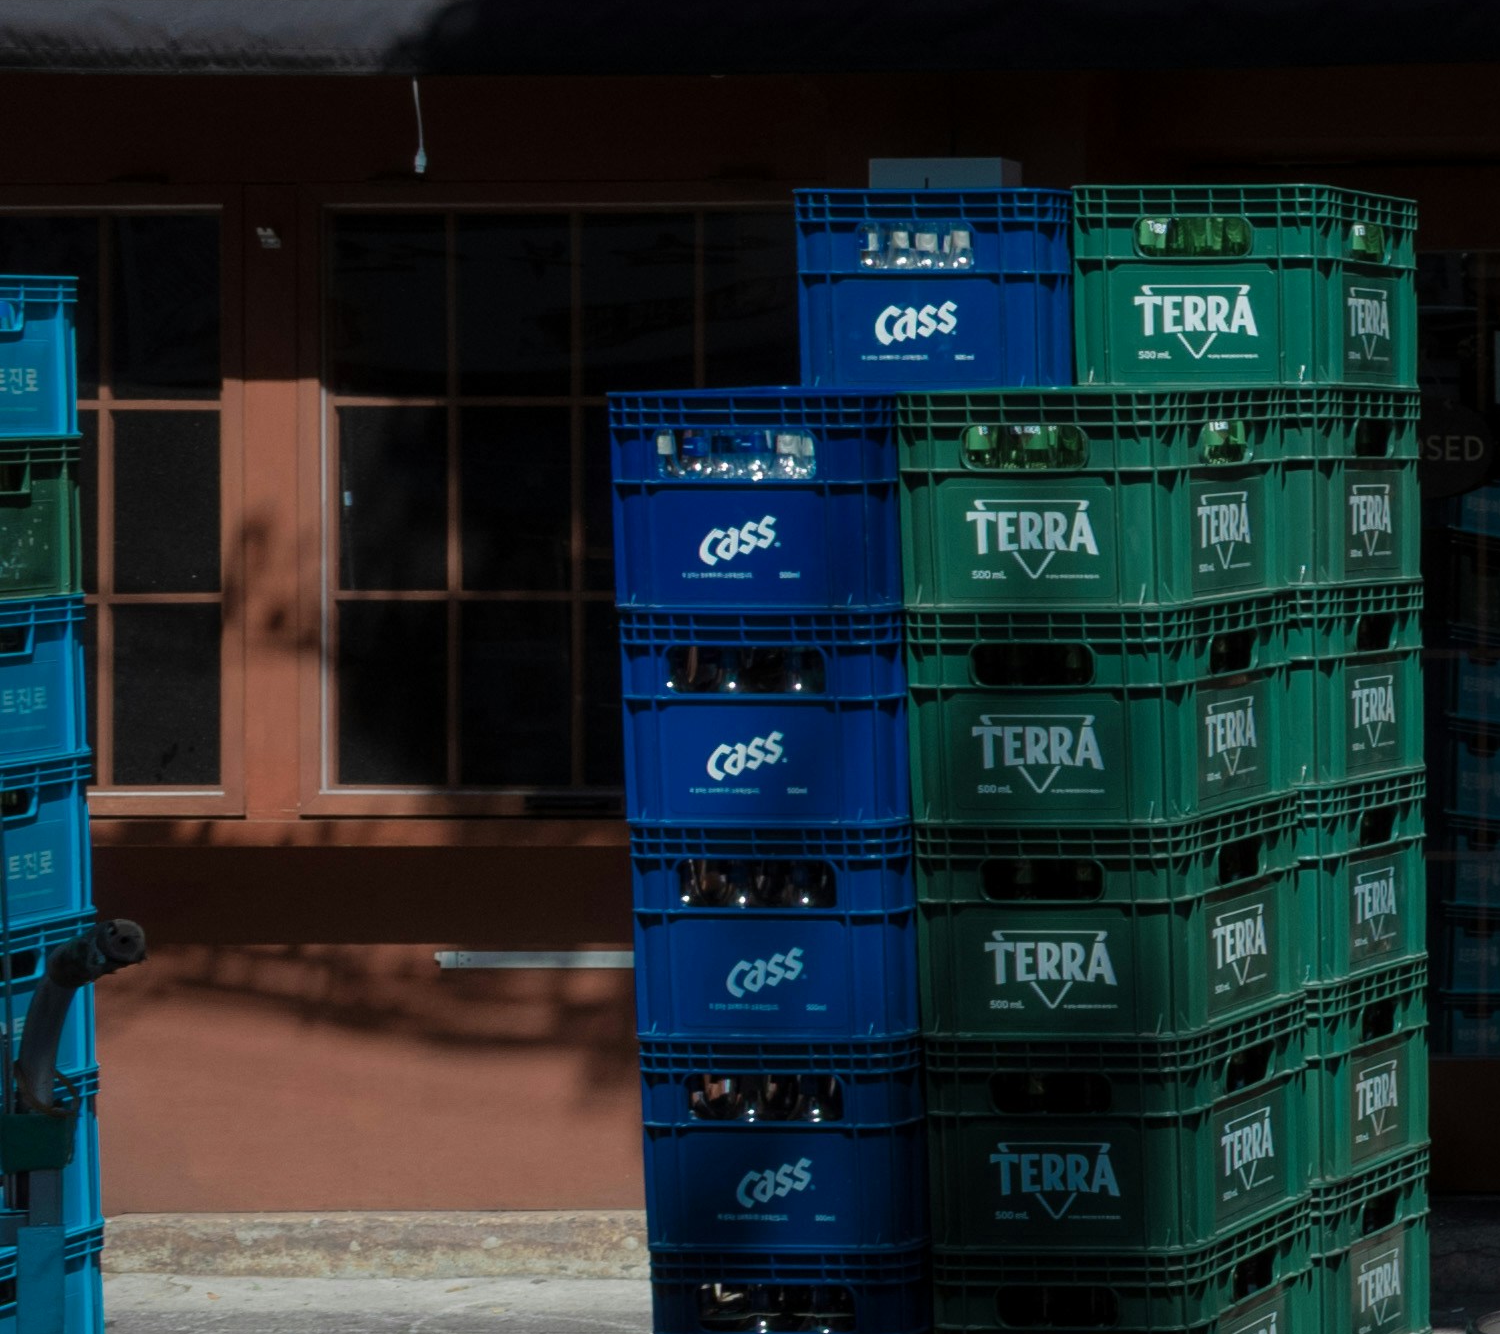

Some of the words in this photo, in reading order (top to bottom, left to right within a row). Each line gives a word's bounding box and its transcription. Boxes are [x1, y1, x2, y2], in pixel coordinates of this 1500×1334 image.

[874, 299, 958, 346] Cass
[697, 513, 781, 565] Cass
[706, 730, 786, 783] Cass
[725, 945, 804, 999] Cass
[736, 1156, 812, 1209] Cass
